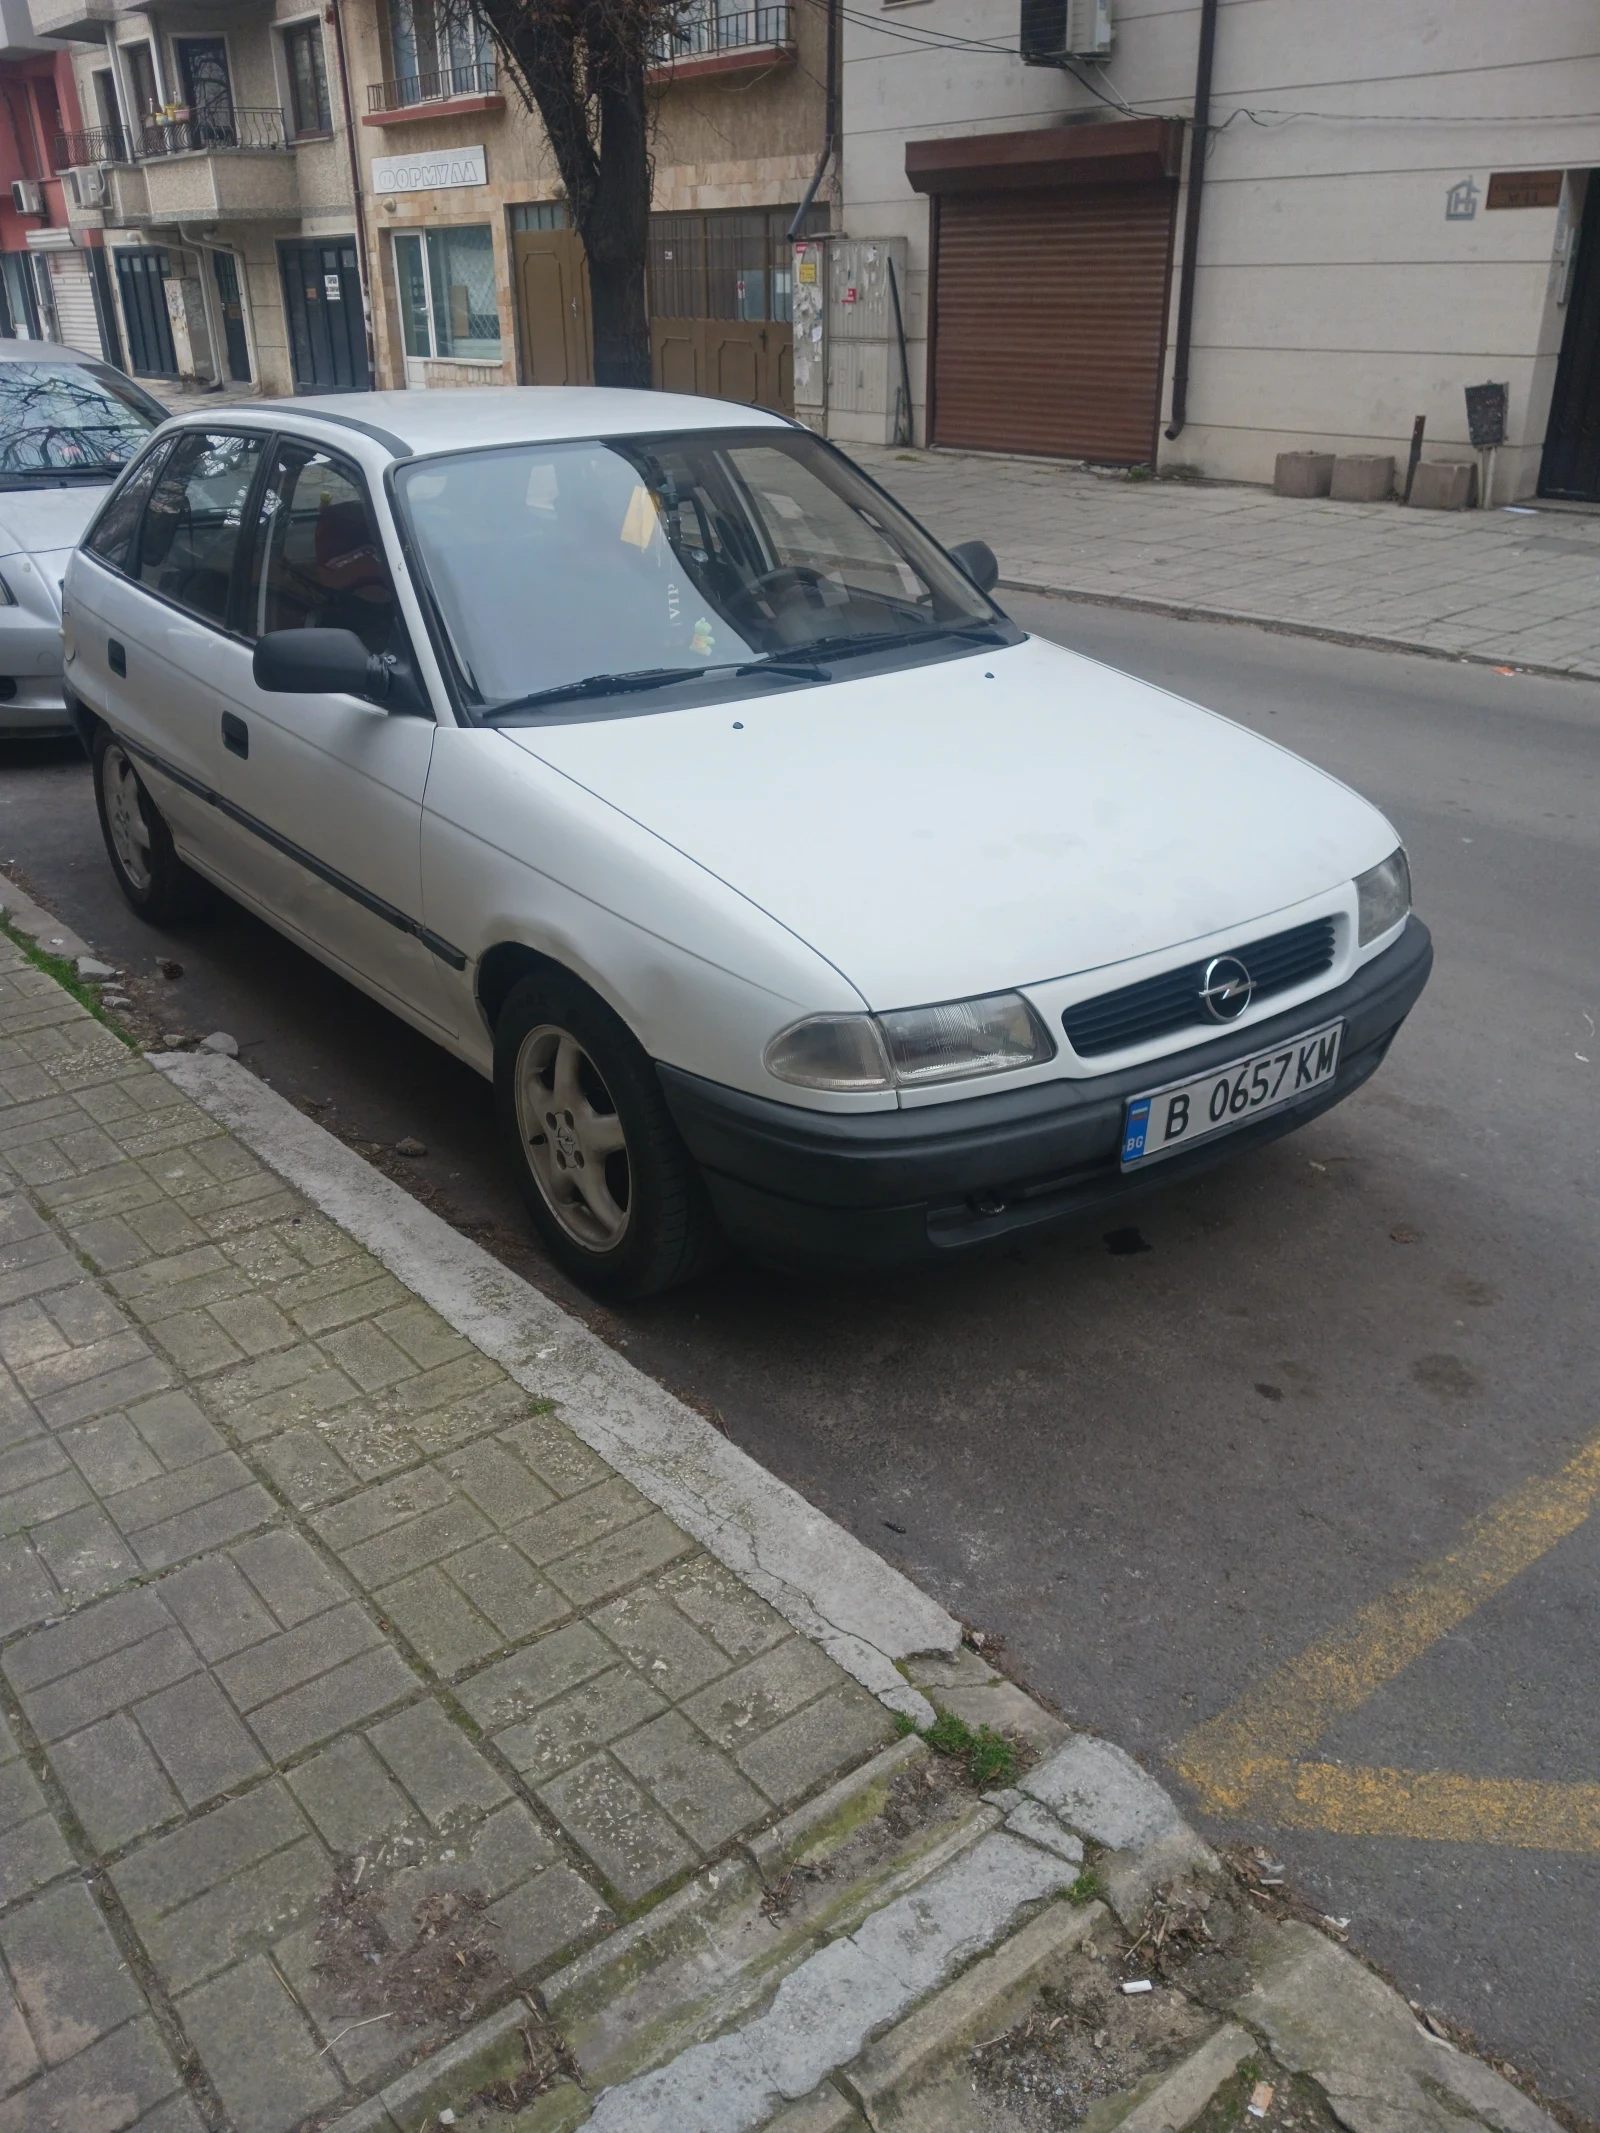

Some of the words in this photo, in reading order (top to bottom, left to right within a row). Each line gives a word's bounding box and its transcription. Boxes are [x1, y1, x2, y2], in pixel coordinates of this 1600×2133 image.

[379, 161, 478, 189] ФОРМУЛА
[667, 583, 680, 620] VIP
[1164, 1093, 1190, 1141] B
[1209, 1051, 1293, 1122] 0657
[1295, 1031, 1338, 1089] KM
[1126, 1135, 1144, 1152] BG
